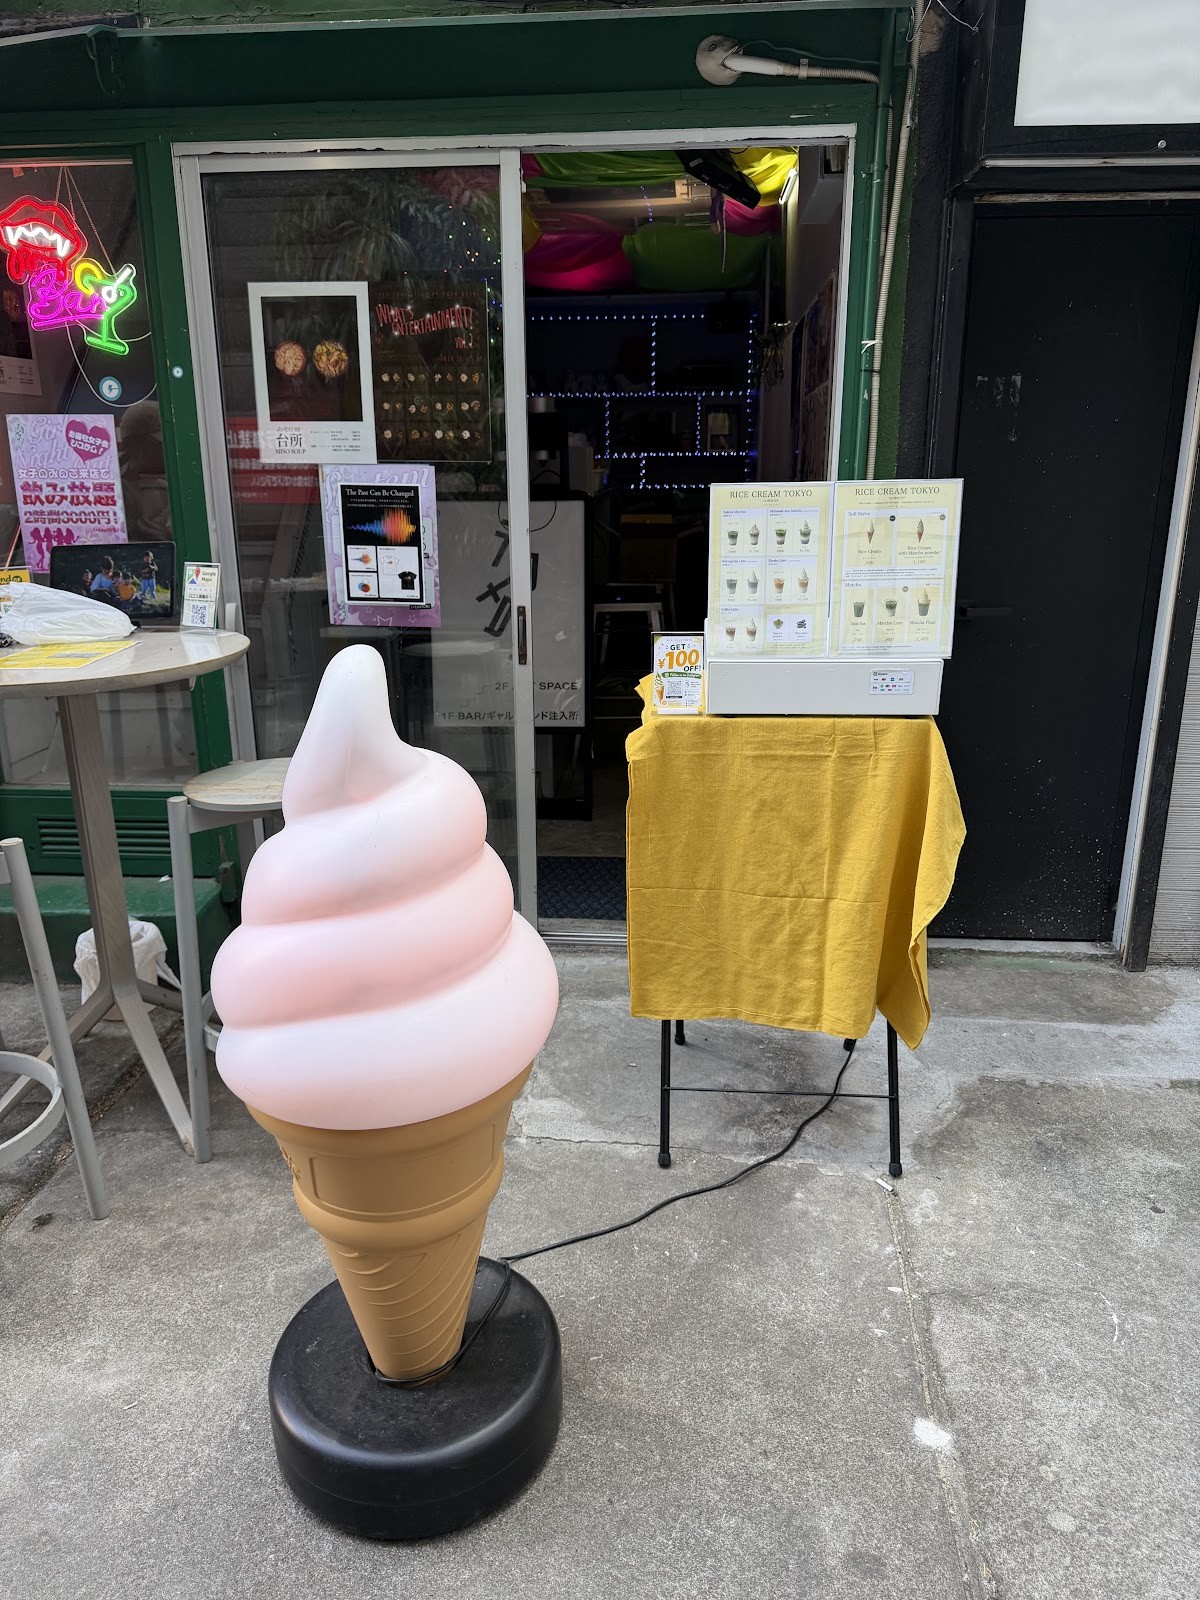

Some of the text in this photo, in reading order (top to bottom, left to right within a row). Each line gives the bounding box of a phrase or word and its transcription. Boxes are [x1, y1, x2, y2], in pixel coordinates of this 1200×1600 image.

[30, 269, 110, 319] Bar
[391, 305, 474, 336] ENTERTAINMENT?
[276, 433, 303, 448] 台所
[20, 481, 117, 507] 飲み放題
[345, 488, 357, 496] The
[369, 489, 381, 497] Can
[382, 489, 390, 497] Be
[390, 490, 415, 498] Changed
[751, 490, 781, 498] CREAM
[783, 489, 813, 497] TOKYO
[855, 486, 940, 496] RICE CREAM TOKYO
[670, 643, 686, 651] GET
[495, 682, 509, 690] 2F
[539, 682, 578, 690] SPACE
[441, 712, 454, 720] 1F
